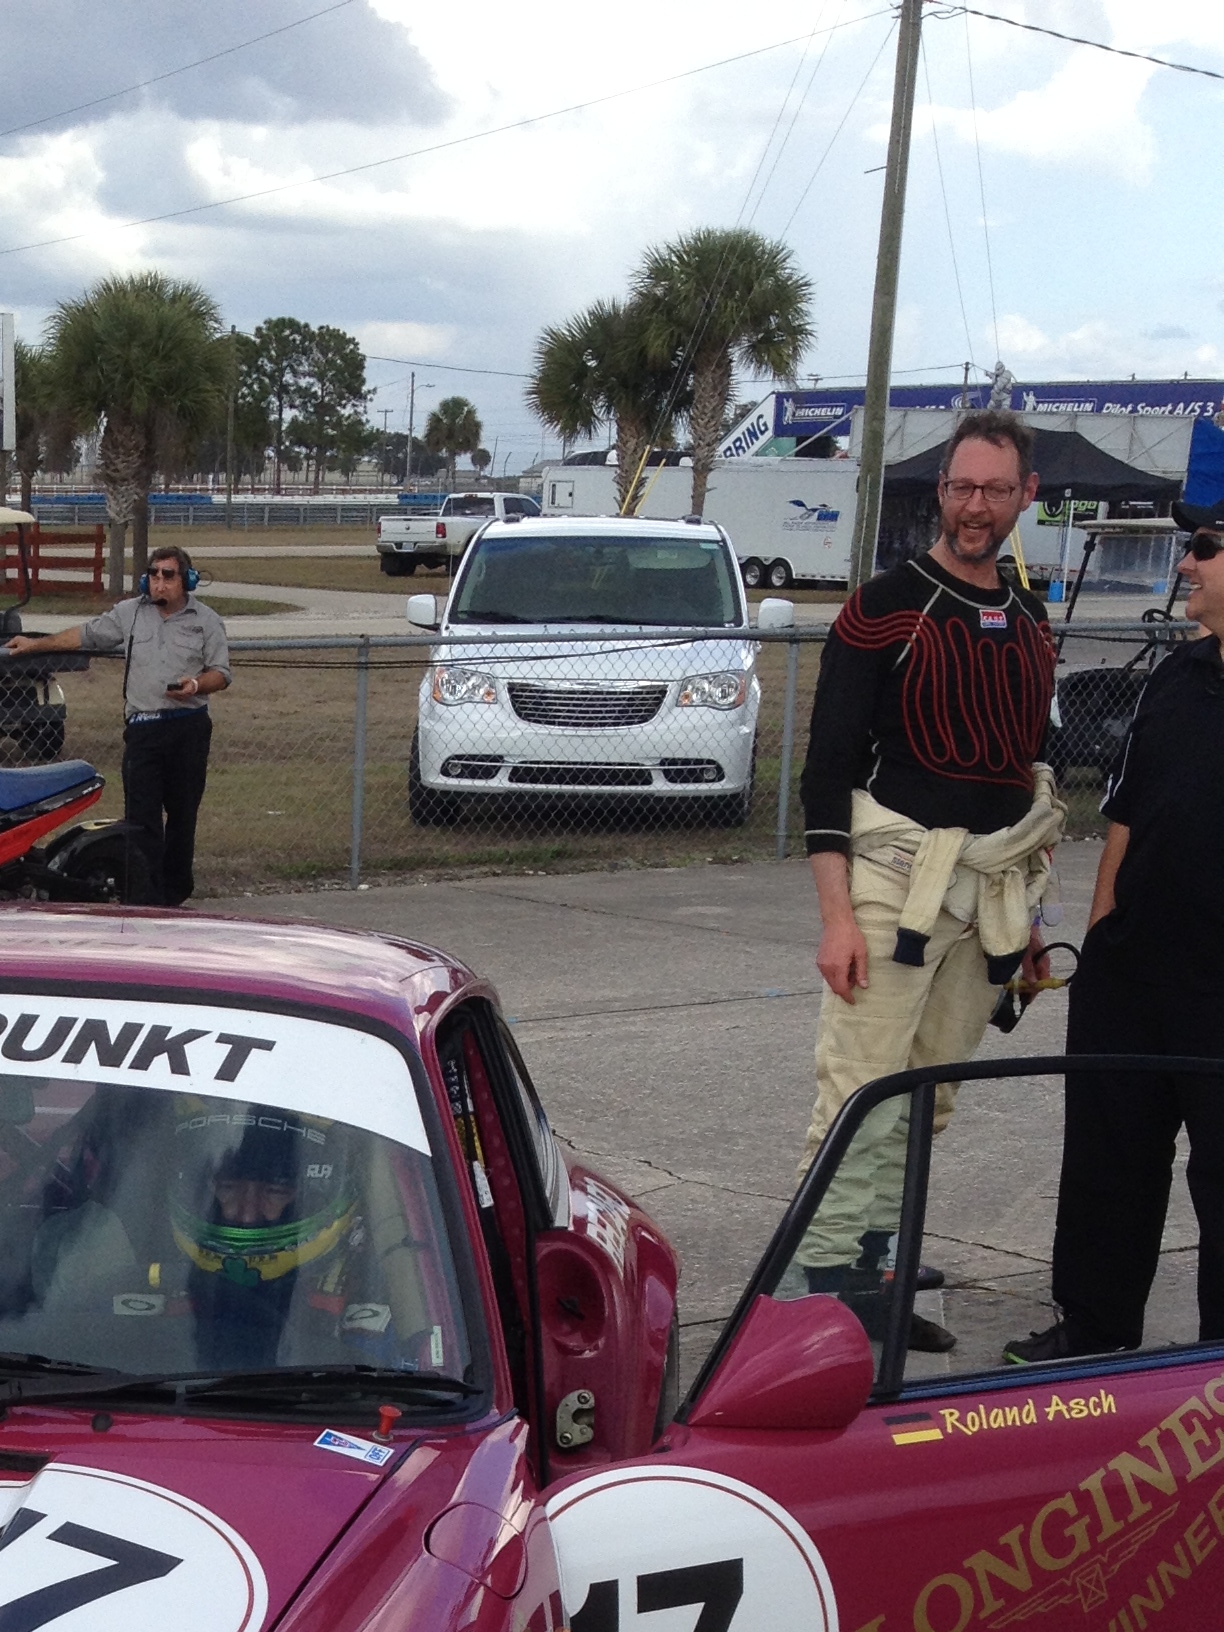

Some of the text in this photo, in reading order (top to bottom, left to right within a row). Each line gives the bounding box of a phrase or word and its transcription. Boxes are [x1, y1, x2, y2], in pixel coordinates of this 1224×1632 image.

[794, 405, 844, 418] MICHELIN
[1036, 402, 1094, 413] MICHELIN
[1102, 402, 1133, 414] Pilot
[1137, 402, 1174, 415] Sport
[721, 413, 770, 458] BRING
[175, 1113, 327, 1146] PORSCHE
[939, 1389, 1117, 1436] Roland Asch
